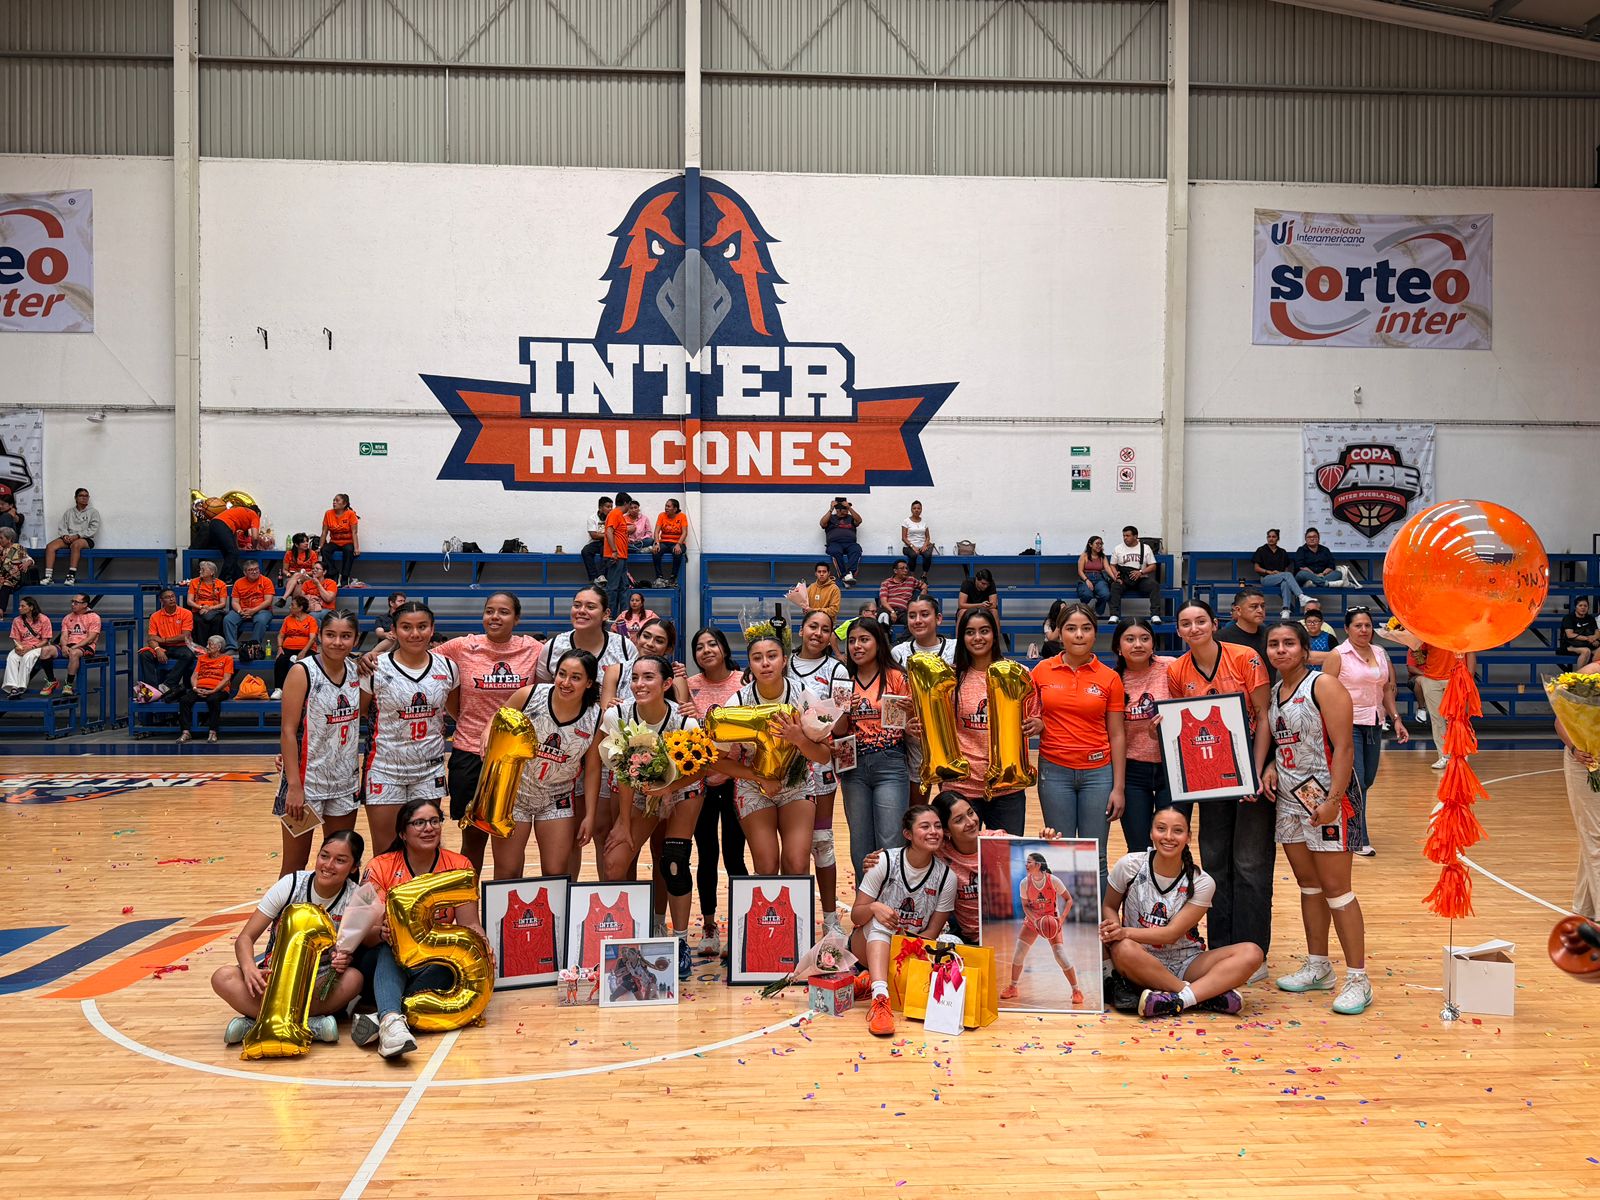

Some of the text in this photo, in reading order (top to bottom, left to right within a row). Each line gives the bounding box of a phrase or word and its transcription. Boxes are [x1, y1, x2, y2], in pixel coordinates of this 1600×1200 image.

[1296, 233, 1366, 244] Interamericana
[1303, 225, 1362, 235] Universidad
[1270, 259, 1470, 305] sorteo
[0, 288, 66, 318] ter
[1375, 305, 1467, 335] inter
[529, 342, 852, 416] INTER
[529, 427, 853, 477] HALCONES
[1350, 447, 1392, 461] COPA
[1339, 463, 1421, 493] ABE
[1338, 492, 1358, 502] INTER
[1359, 491, 1385, 499] PUEBLA
[484, 674, 520, 683] INTER
[405, 705, 432, 714] INTER
[340, 725, 349, 746] 9
[409, 720, 428, 741] 19
[1201, 746, 1214, 760] 11
[1280, 747, 1297, 769] 12
[526, 931, 531, 942] 1
[768, 927, 775, 939] 7
